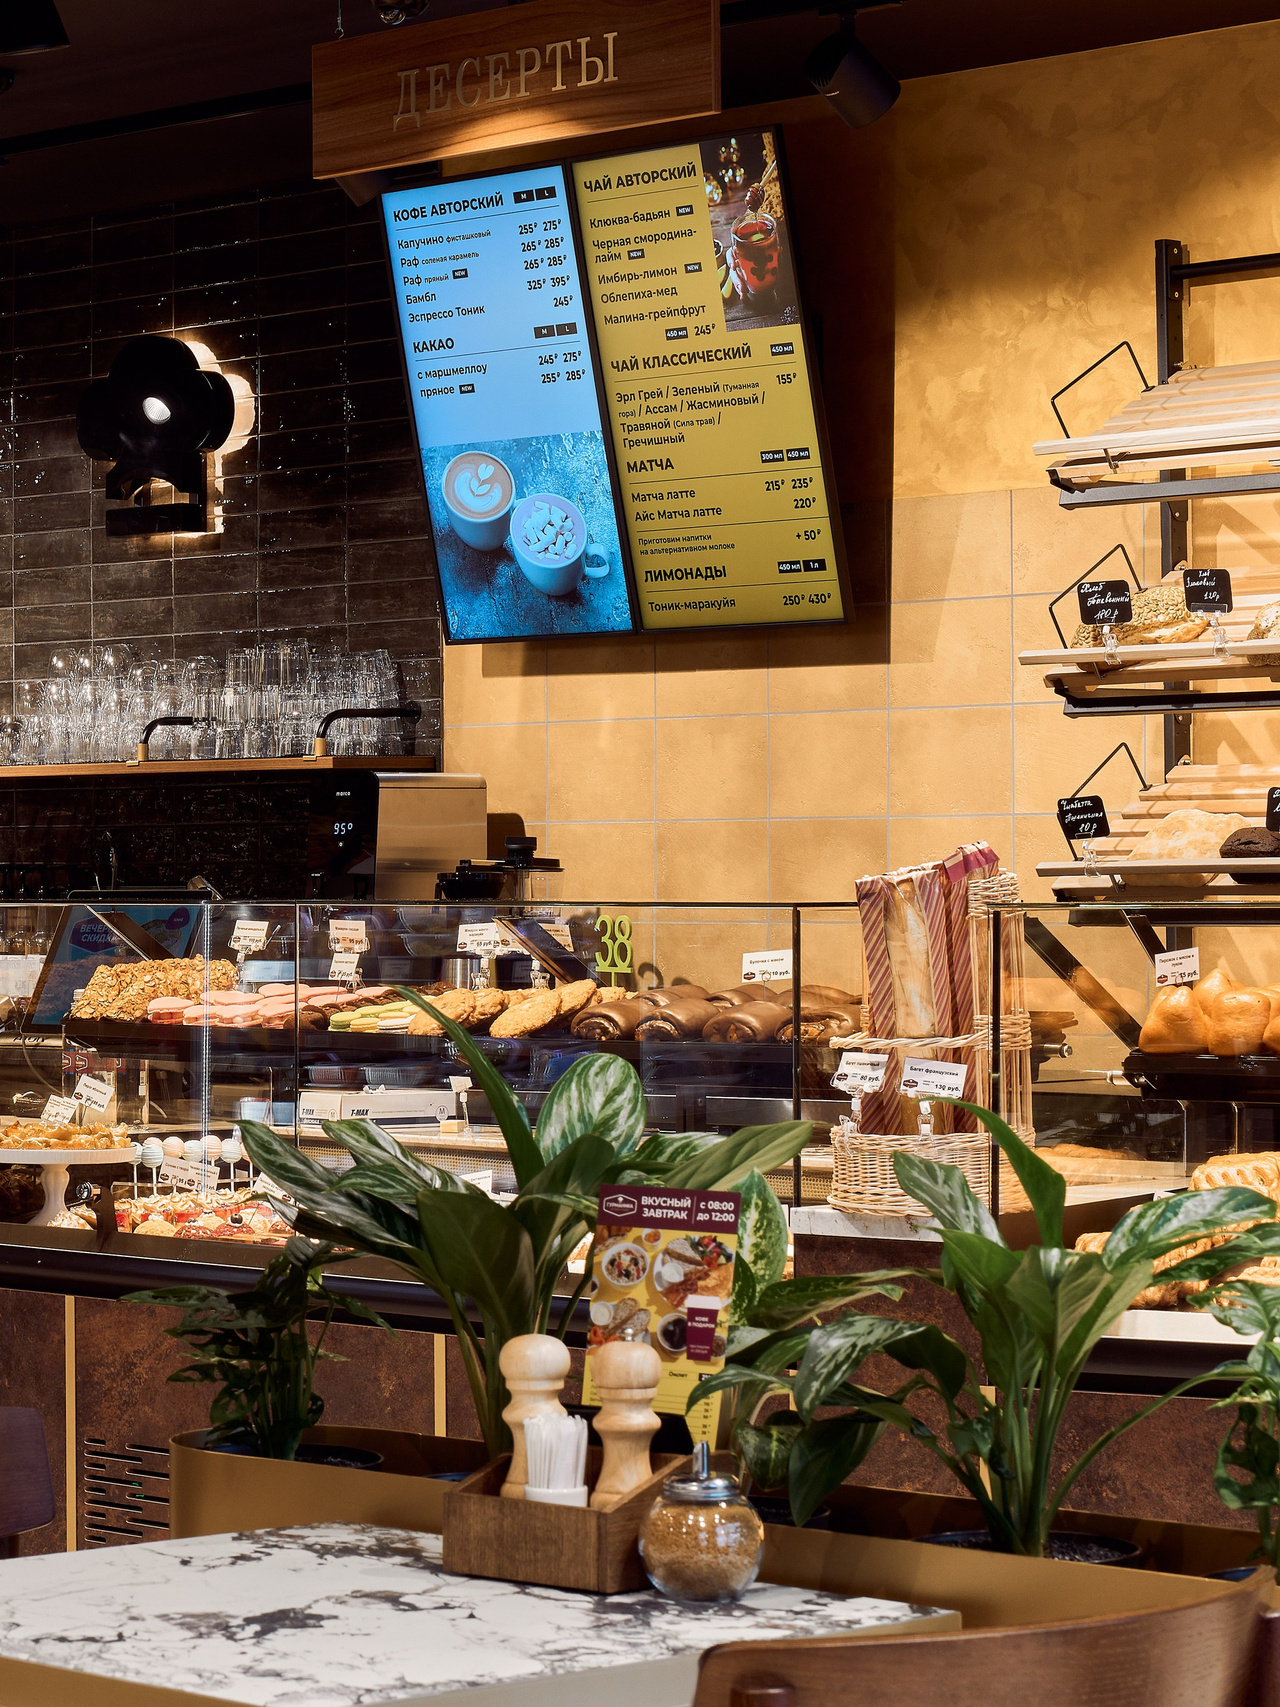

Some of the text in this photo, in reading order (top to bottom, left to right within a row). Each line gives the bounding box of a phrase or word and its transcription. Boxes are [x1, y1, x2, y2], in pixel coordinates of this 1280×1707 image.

[393, 31, 619, 131] ДЕСЕРТЫ
[584, 162, 697, 193] ЧАЙ АВТОРСКИЙ
[393, 191, 504, 222] КОФЕ АВТОРСКИЙ
[590, 208, 670, 229] Клюква-бадьян
[398, 234, 444, 249] Капучино
[446, 230, 491, 243] фисташковый
[592, 228, 697, 250] Черная смородина-
[401, 256, 419, 268] Раф
[422, 255, 447, 265] соленая
[449, 251, 480, 262] карамель
[595, 252, 621, 264] лайм
[403, 275, 422, 286] Раф
[424, 274, 449, 284] пряный
[598, 266, 677, 285] Имбирь-лимон
[406, 292, 437, 305] Бамбл
[601, 286, 677, 304] Облепиха-мед
[408, 309, 453, 324] Эспрессо
[455, 305, 485, 317] Тоник
[604, 304, 706, 325] Малина-грейпфрут
[413, 337, 454, 353] КАКАО
[611, 355, 639, 373] ЧАЙ
[642, 343, 752, 369] КЛАССИЧЕСКИЙ
[418, 371, 423, 379] с
[425, 364, 487, 380] маршмеллоу
[420, 385, 454, 399] пряное
[616, 392, 636, 404] Эрл
[638, 388, 663, 401] Грей
[672, 382, 720, 397] Зеленый
[723, 381, 759, 393] (Туманная
[619, 394, 759, 418] гора) Ассам Жасминовый
[620, 416, 715, 434] Травяной (Сила трав)
[623, 433, 685, 449] Гречишный
[627, 457, 674, 473] МАТЧА
[632, 491, 664, 503] Матча
[666, 488, 695, 500] латте
[635, 510, 655, 522] Айс
[658, 508, 690, 520] Матча
[693, 506, 722, 517] латте
[638, 535, 680, 546] Приготовим
[682, 533, 712, 543] напитки
[650, 544, 707, 555] альтернативном
[709, 542, 735, 551] молоке
[645, 565, 727, 583] ЛИМОНАДЫ
[649, 598, 736, 612] Тоник-маракуйя
[333, 822, 353, 835] 95°
[595, 915, 634, 968] 38
[868, 1075, 880, 1083] руб.
[910, 1065, 959, 1077] Багет французский
[641, 1195, 691, 1208] ВКУСНЫЙ
[708, 1201, 734, 1211] 08:00
[642, 1208, 688, 1219] ЗАВТРАК
[711, 1212, 735, 1222] 12:00
